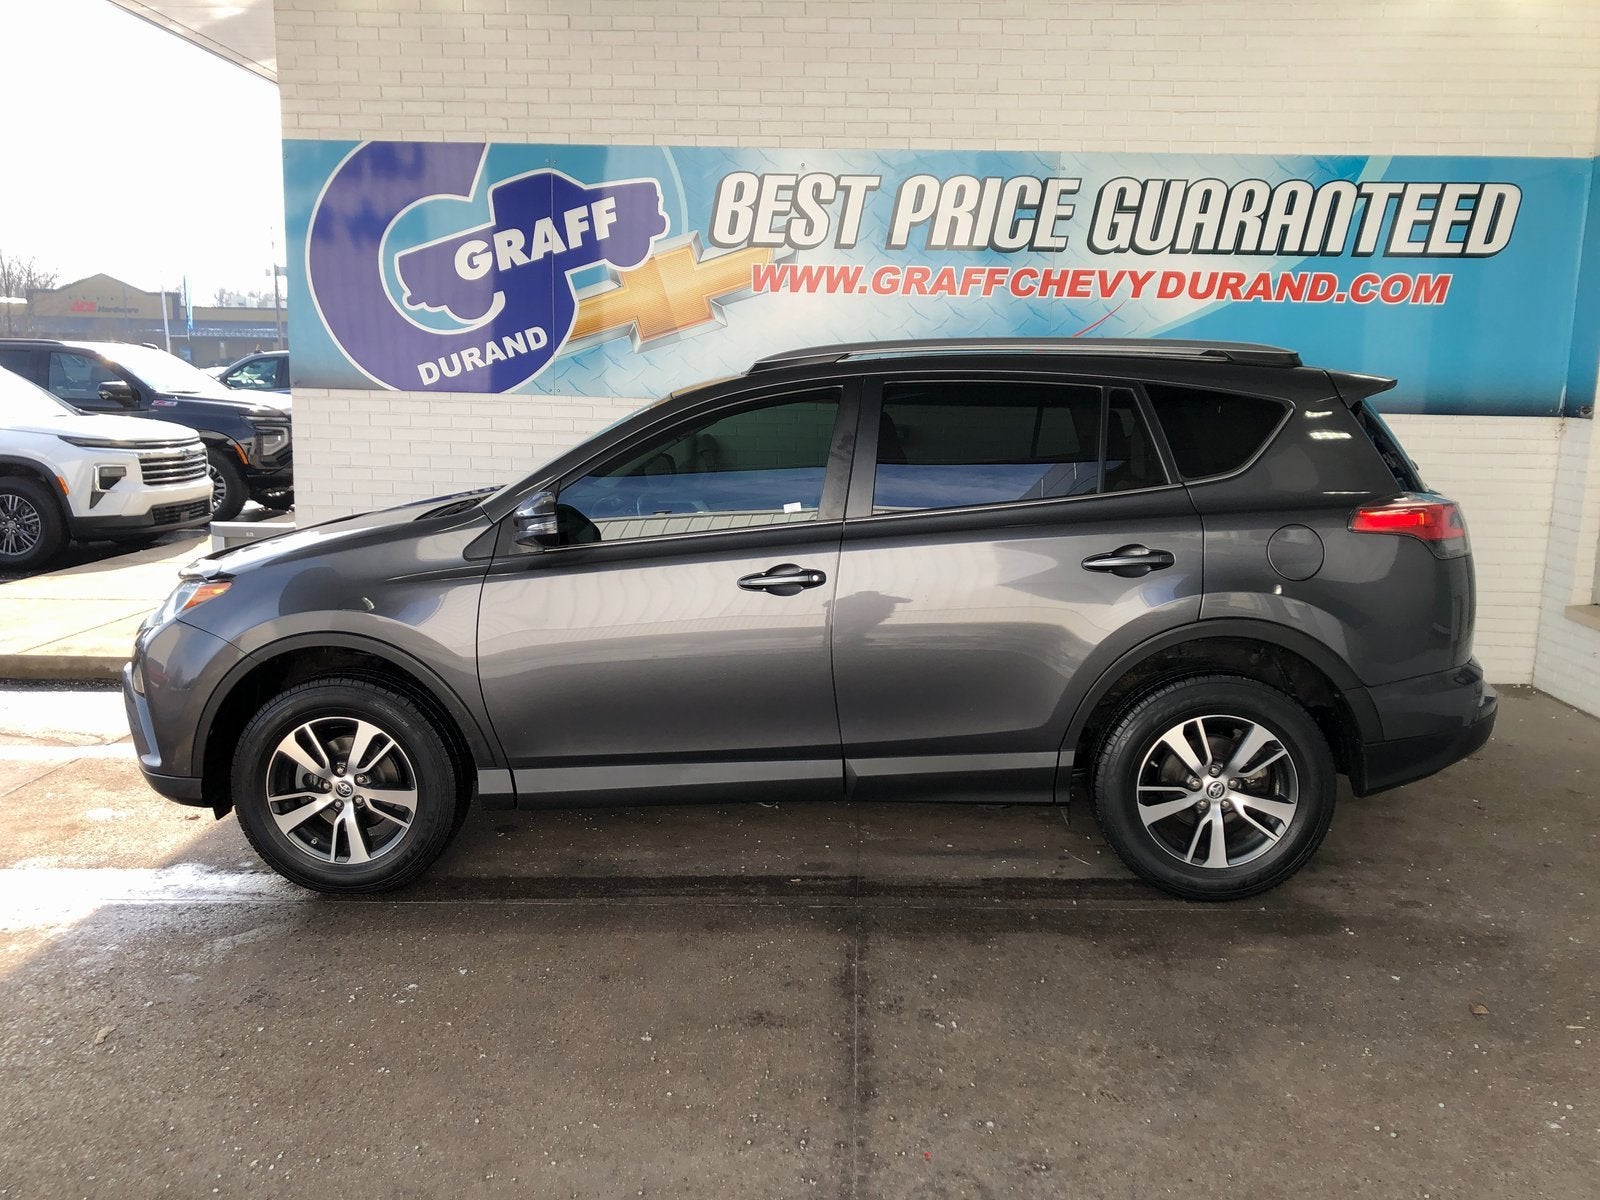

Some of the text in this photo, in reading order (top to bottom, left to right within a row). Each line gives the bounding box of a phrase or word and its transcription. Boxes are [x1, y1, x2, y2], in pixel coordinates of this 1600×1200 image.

[454, 197, 617, 280] GRAFF
[709, 171, 1524, 258] BEST PRICE GUARANTEED
[752, 263, 1453, 305] WWW.GRAFFCHEVYDURAND.COM
[417, 326, 548, 385] DURAND
